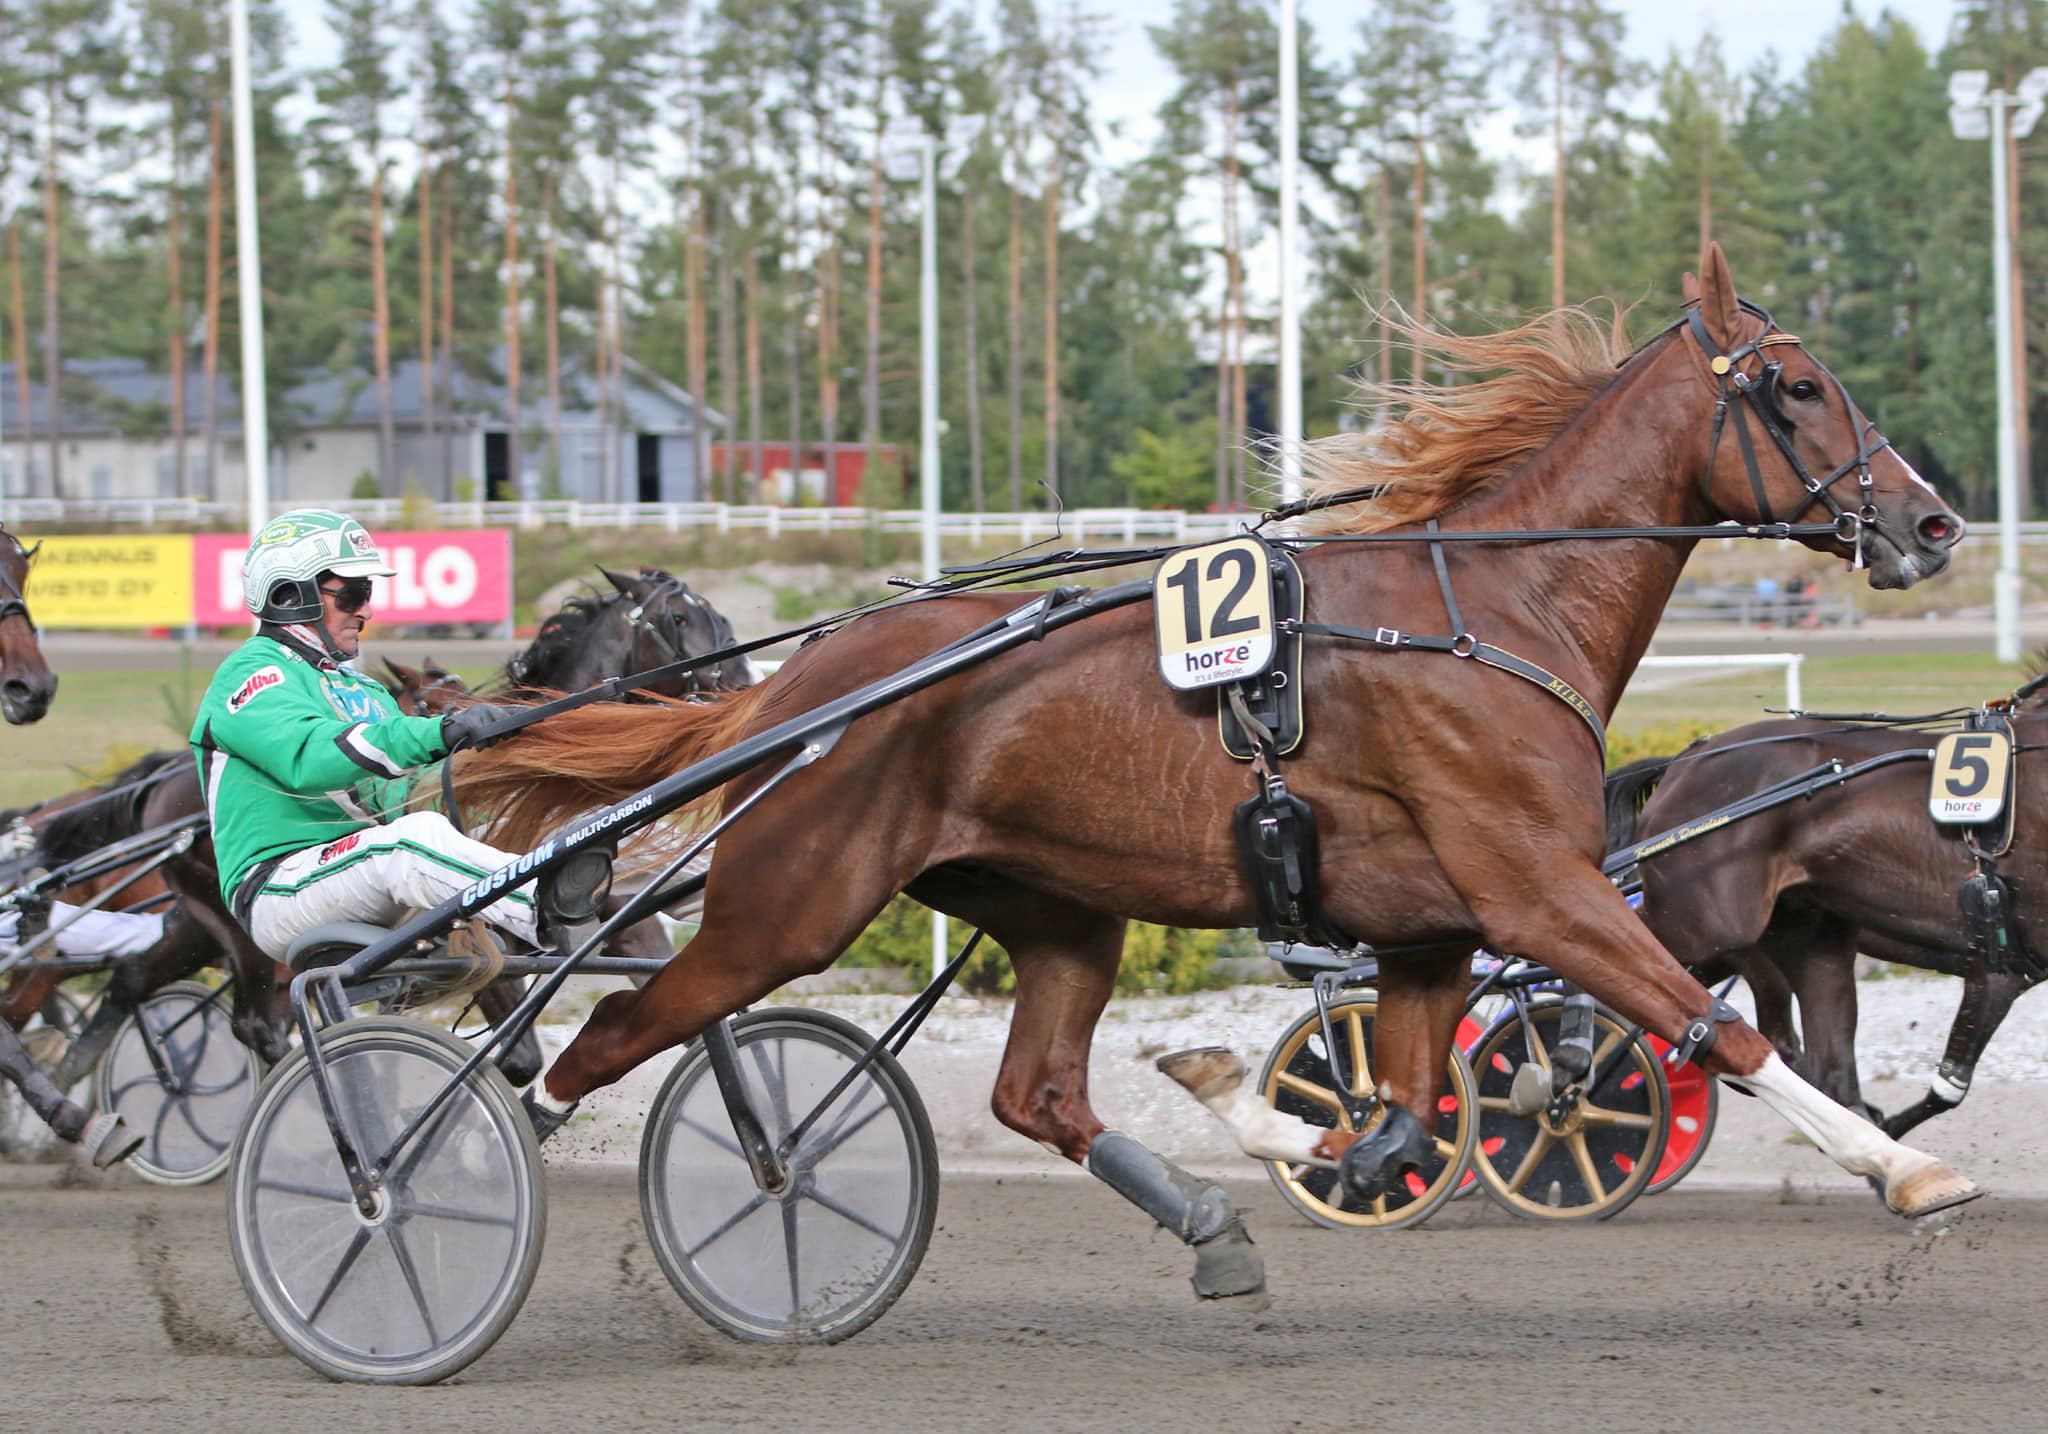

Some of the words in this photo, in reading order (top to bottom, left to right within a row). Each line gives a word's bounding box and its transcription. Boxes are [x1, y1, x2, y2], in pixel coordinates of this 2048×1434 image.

[1167, 548, 1261, 644] 12
[1186, 645, 1250, 673] horze
[240, 673, 280, 702] Mira
[1944, 736, 1993, 797] 5
[565, 794, 653, 848] MULTICARBON
[1944, 799, 1982, 812] horze
[461, 839, 557, 907] CUSTOM
